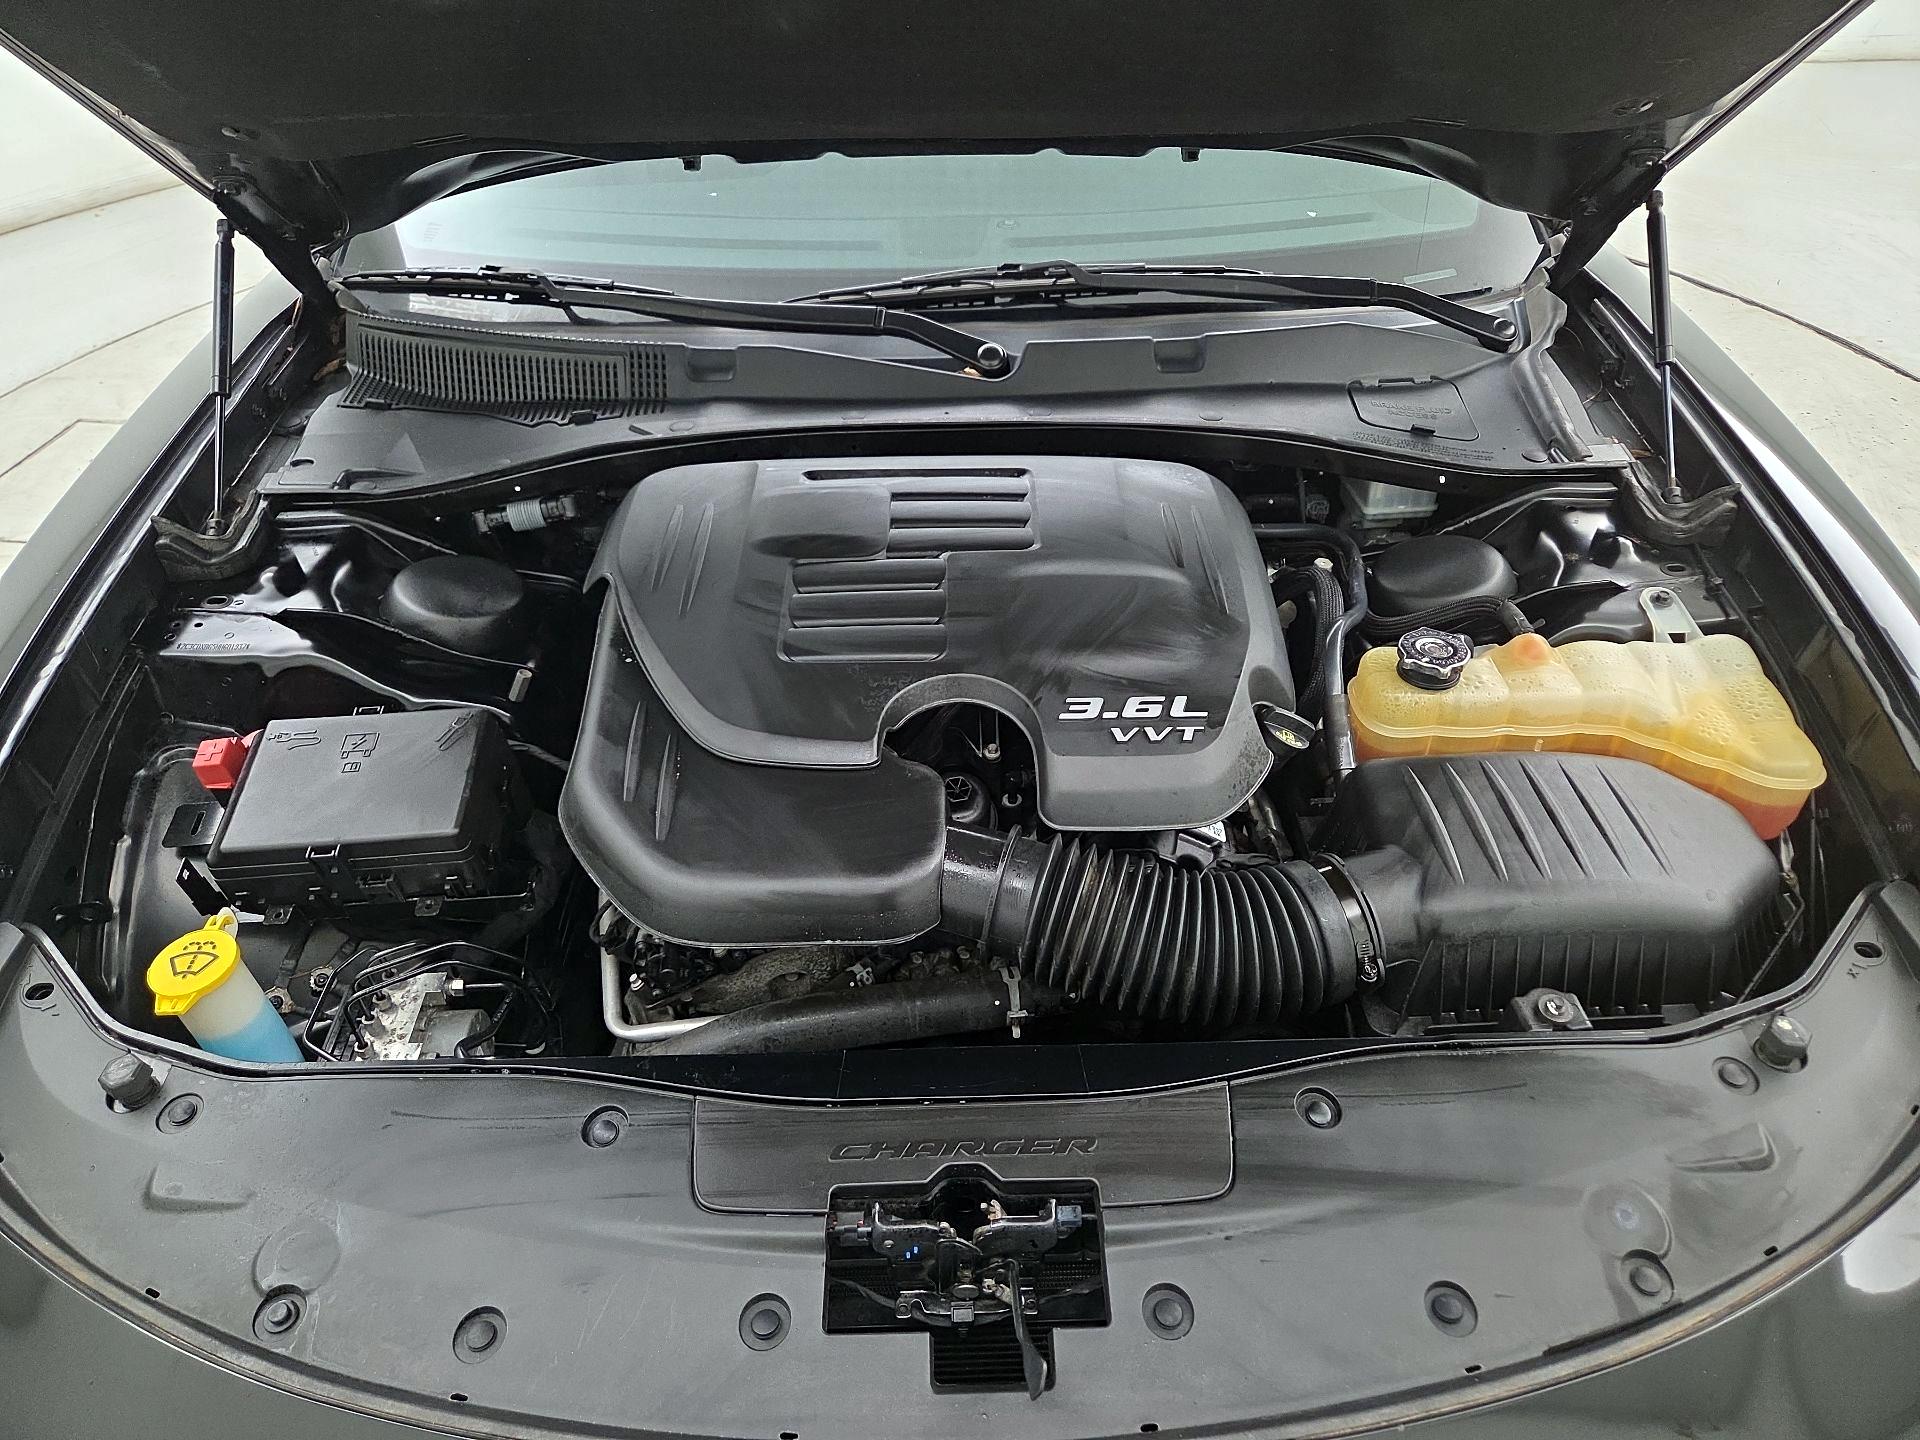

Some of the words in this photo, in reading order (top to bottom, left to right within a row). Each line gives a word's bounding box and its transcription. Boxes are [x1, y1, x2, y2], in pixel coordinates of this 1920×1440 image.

[1058, 695, 1209, 720] 3.6L
[1110, 726, 1205, 742] VVT
[828, 1138, 1098, 1162] CHARGER
